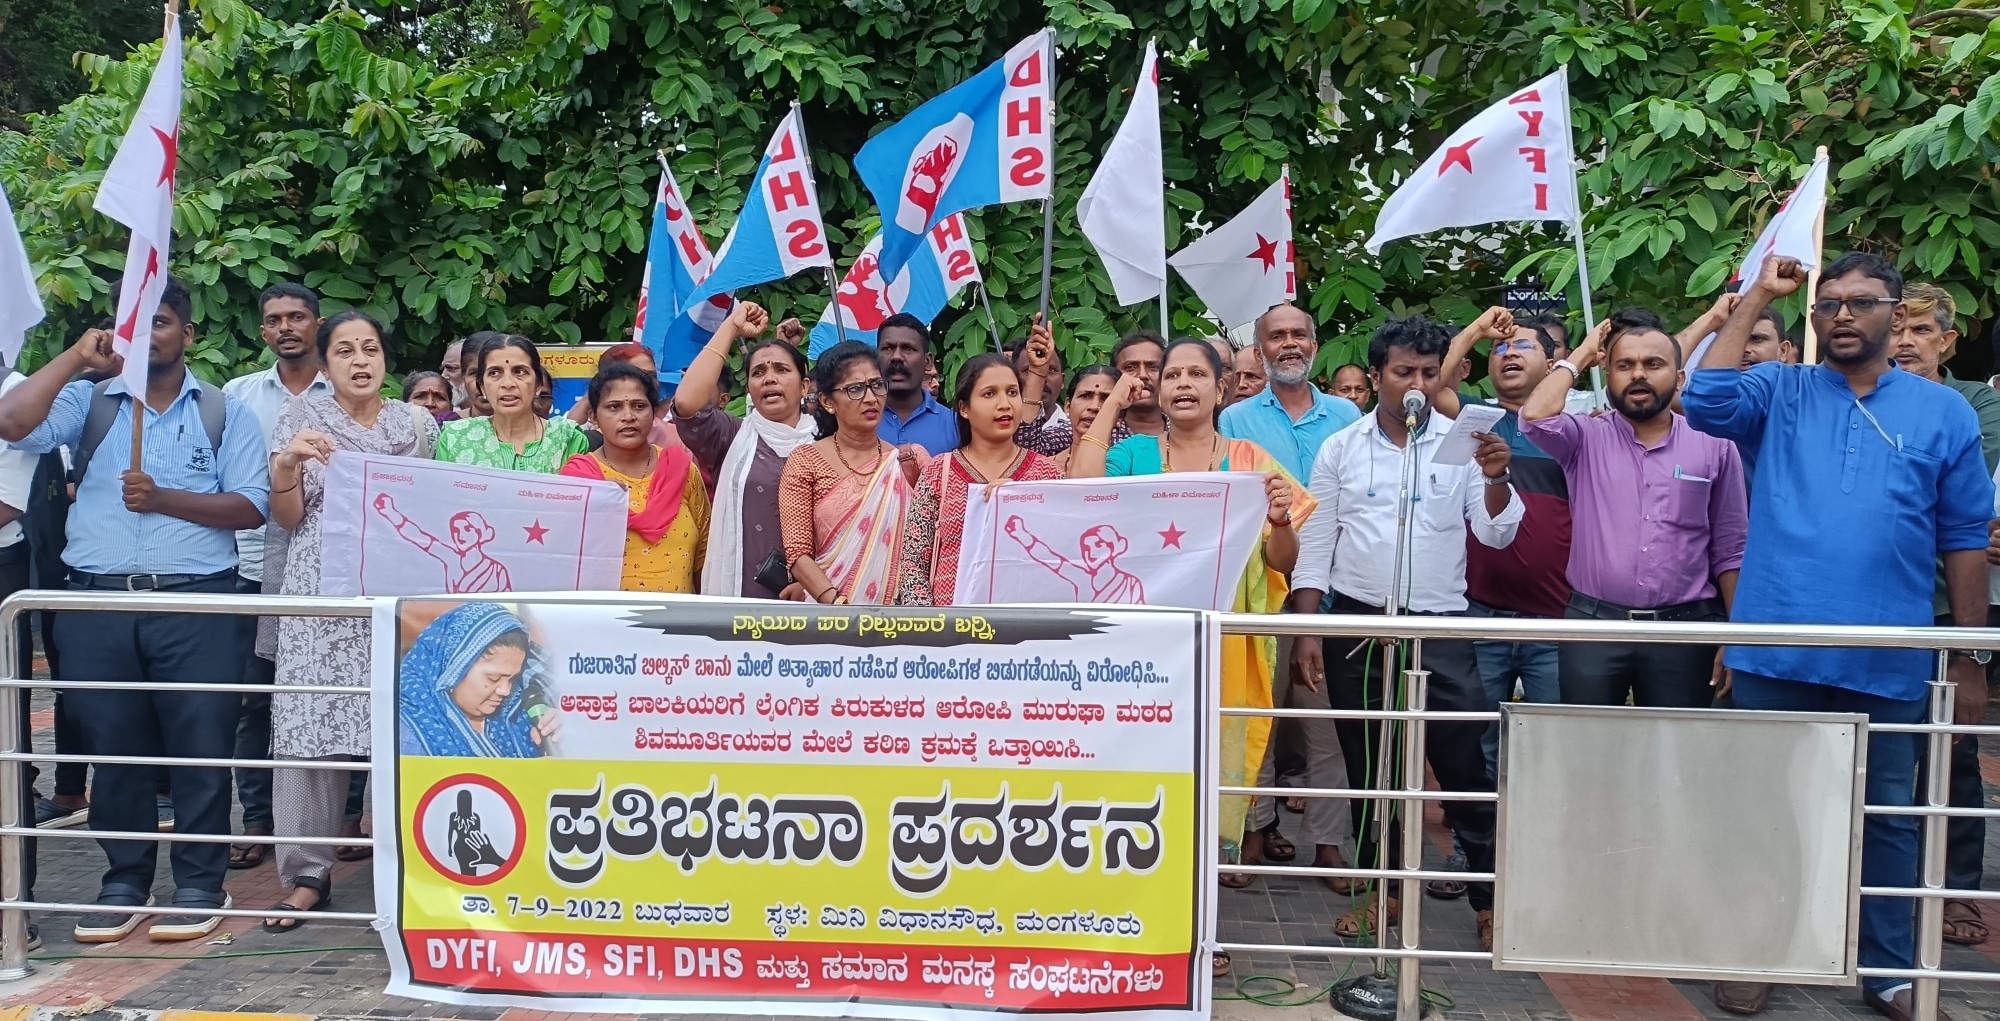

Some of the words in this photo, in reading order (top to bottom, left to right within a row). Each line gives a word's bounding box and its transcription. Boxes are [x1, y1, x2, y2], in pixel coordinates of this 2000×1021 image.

[454, 480, 488, 492] ಸಮಾನತೆ
[1084, 492, 1120, 502] ಸಮಾನತೆ
[732, 614, 807, 639] ನ್ಯಾಯದ
[817, 615, 849, 631] ಪರ
[859, 613, 946, 638] ನಿಲ್ಲುವವರೆ
[955, 615, 996, 640] ಬನ್ನಿ,
[568, 652, 637, 675] ಗುಜರಾತಿನ
[641, 653, 690, 685] ಬಿಲ್ಕಿಸ್
[695, 654, 731, 677] ಬಾನು
[737, 652, 774, 677] ಮೇಲೆ
[778, 656, 844, 687] ಅತ್ಯಾಚಾರ
[849, 654, 898, 679] ನಡೆಸಿದ
[903, 654, 982, 680] ಆರೋಪಿಗಳ
[986, 656, 1082, 691] ಬಿಡುಗಡೆಯನ್ನು
[1086, 657, 1169, 688] ವಿರೋಧಿಸಿ...
[560, 690, 618, 721] ಅಪ್ರಾಪ್ತ
[629, 692, 745, 716] ಬಾಲಕಿಯರಿಗೆ
[756, 692, 820, 722] ಲೈಂಗಿಕ
[830, 694, 925, 718] ಕಿರುಕುಳದ
[936, 695, 1012, 719] ಆರೋಪಿ
[1023, 697, 1105, 725] ಮುರುಘಾ
[1116, 699, 1173, 723] ಮಠದ
[634, 726, 792, 752] ಶಿವಮೂರ್ತಿಯವರ
[802, 729, 853, 753] ಮೇಲೆ
[864, 730, 910, 754] ಕಠಿಣ
[921, 731, 977, 763] ಕ್ರಮಕ್ಕೆ
[988, 737, 1095, 765] ಒತ್ತಾಯಿಸಿ...
[549, 774, 862, 885] ಪ್ರತಿಭಟನಾ
[892, 781, 1163, 893] ಪ್ರದರ್ಶನ
[462, 896, 495, 915] ತಾ.
[635, 901, 730, 925] ಬುಧವಾರ
[766, 903, 808, 937] ಸ್ಥಳ:
[821, 905, 865, 928] ಮಿನಿ
[880, 906, 1002, 934] ವಿಧಾನಸೌಧ,
[1016, 911, 1142, 936] ಮಂಗಳೂರು
[426, 938, 502, 978] DYFI,
[513, 942, 591, 979] JMS,
[603, 944, 664, 981] SFI,
[674, 946, 744, 978] DHS
[757, 954, 811, 988] ಮತ್ತು
[821, 951, 909, 982] ಸಮಾನ
[922, 953, 995, 998] ಮನಸ್ಕ
[1009, 957, 1163, 998] ಸಂಘಟನೆಗಳು
